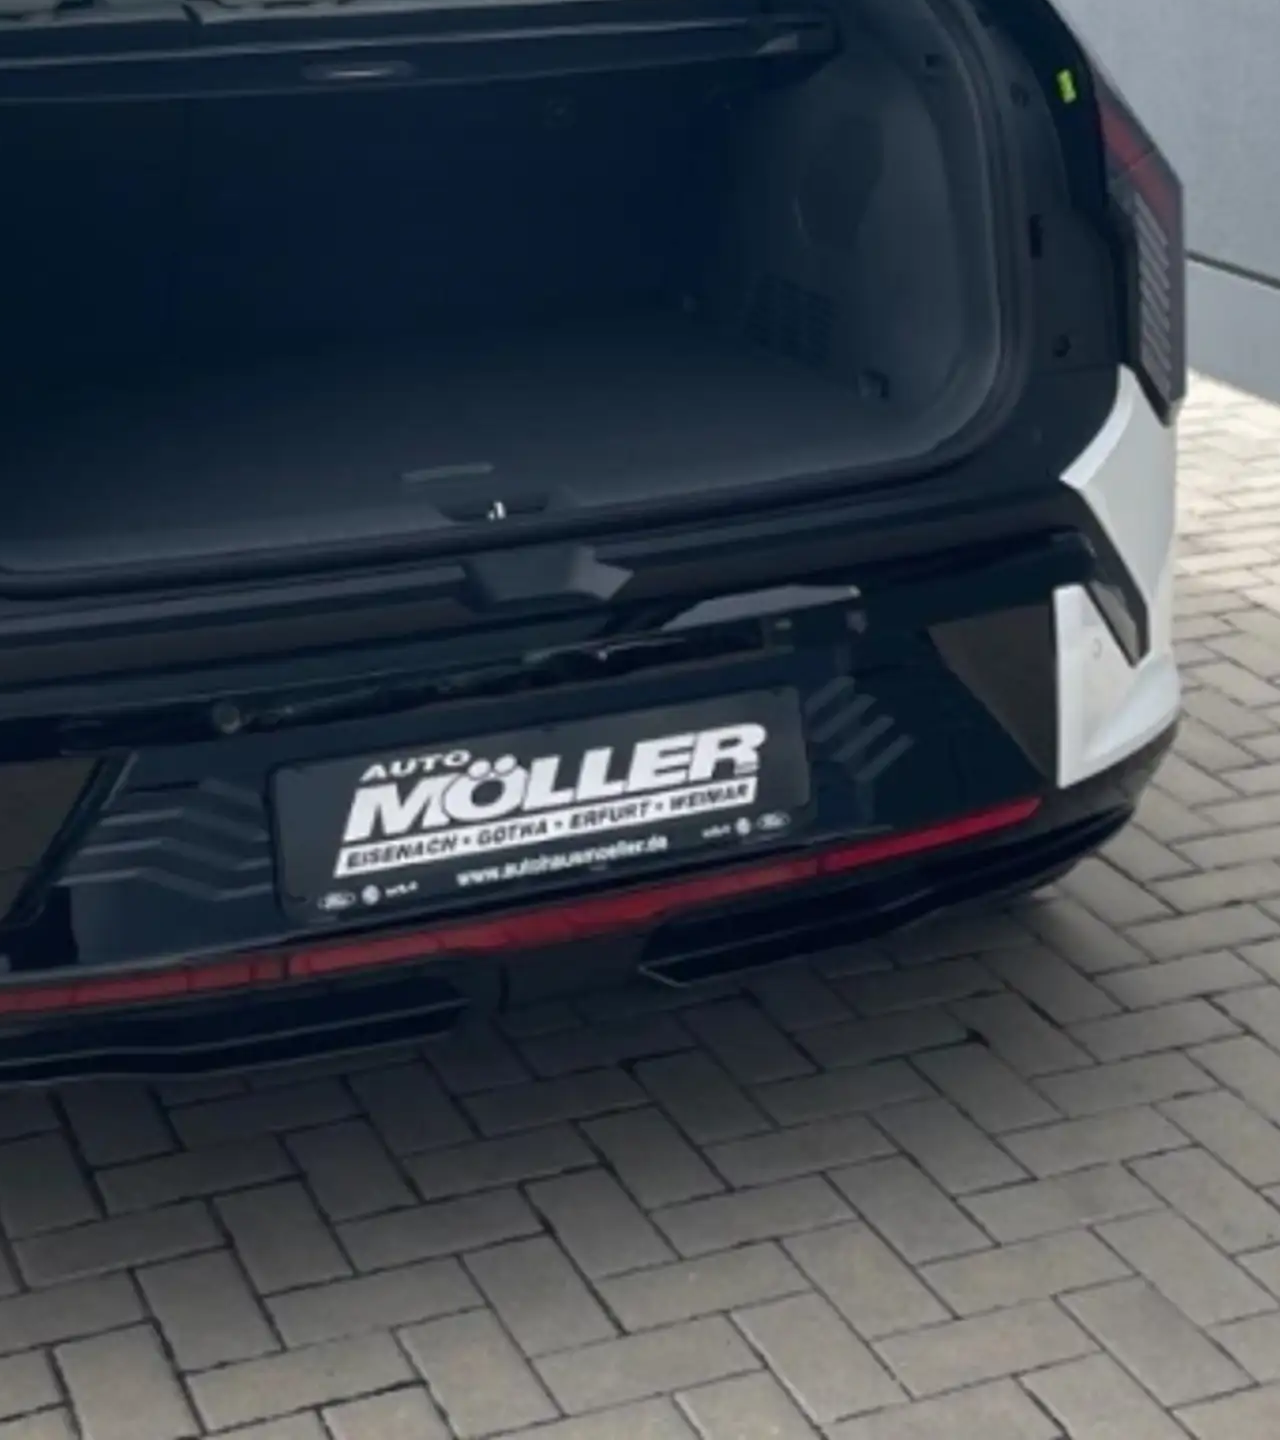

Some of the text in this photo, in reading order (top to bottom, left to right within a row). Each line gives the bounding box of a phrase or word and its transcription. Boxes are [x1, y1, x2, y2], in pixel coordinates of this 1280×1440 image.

[343, 723, 768, 842] MÖLLER
[359, 749, 471, 783] AUTO
[346, 783, 750, 869] EISENACH GOTHA ERFURT WEIMAR
